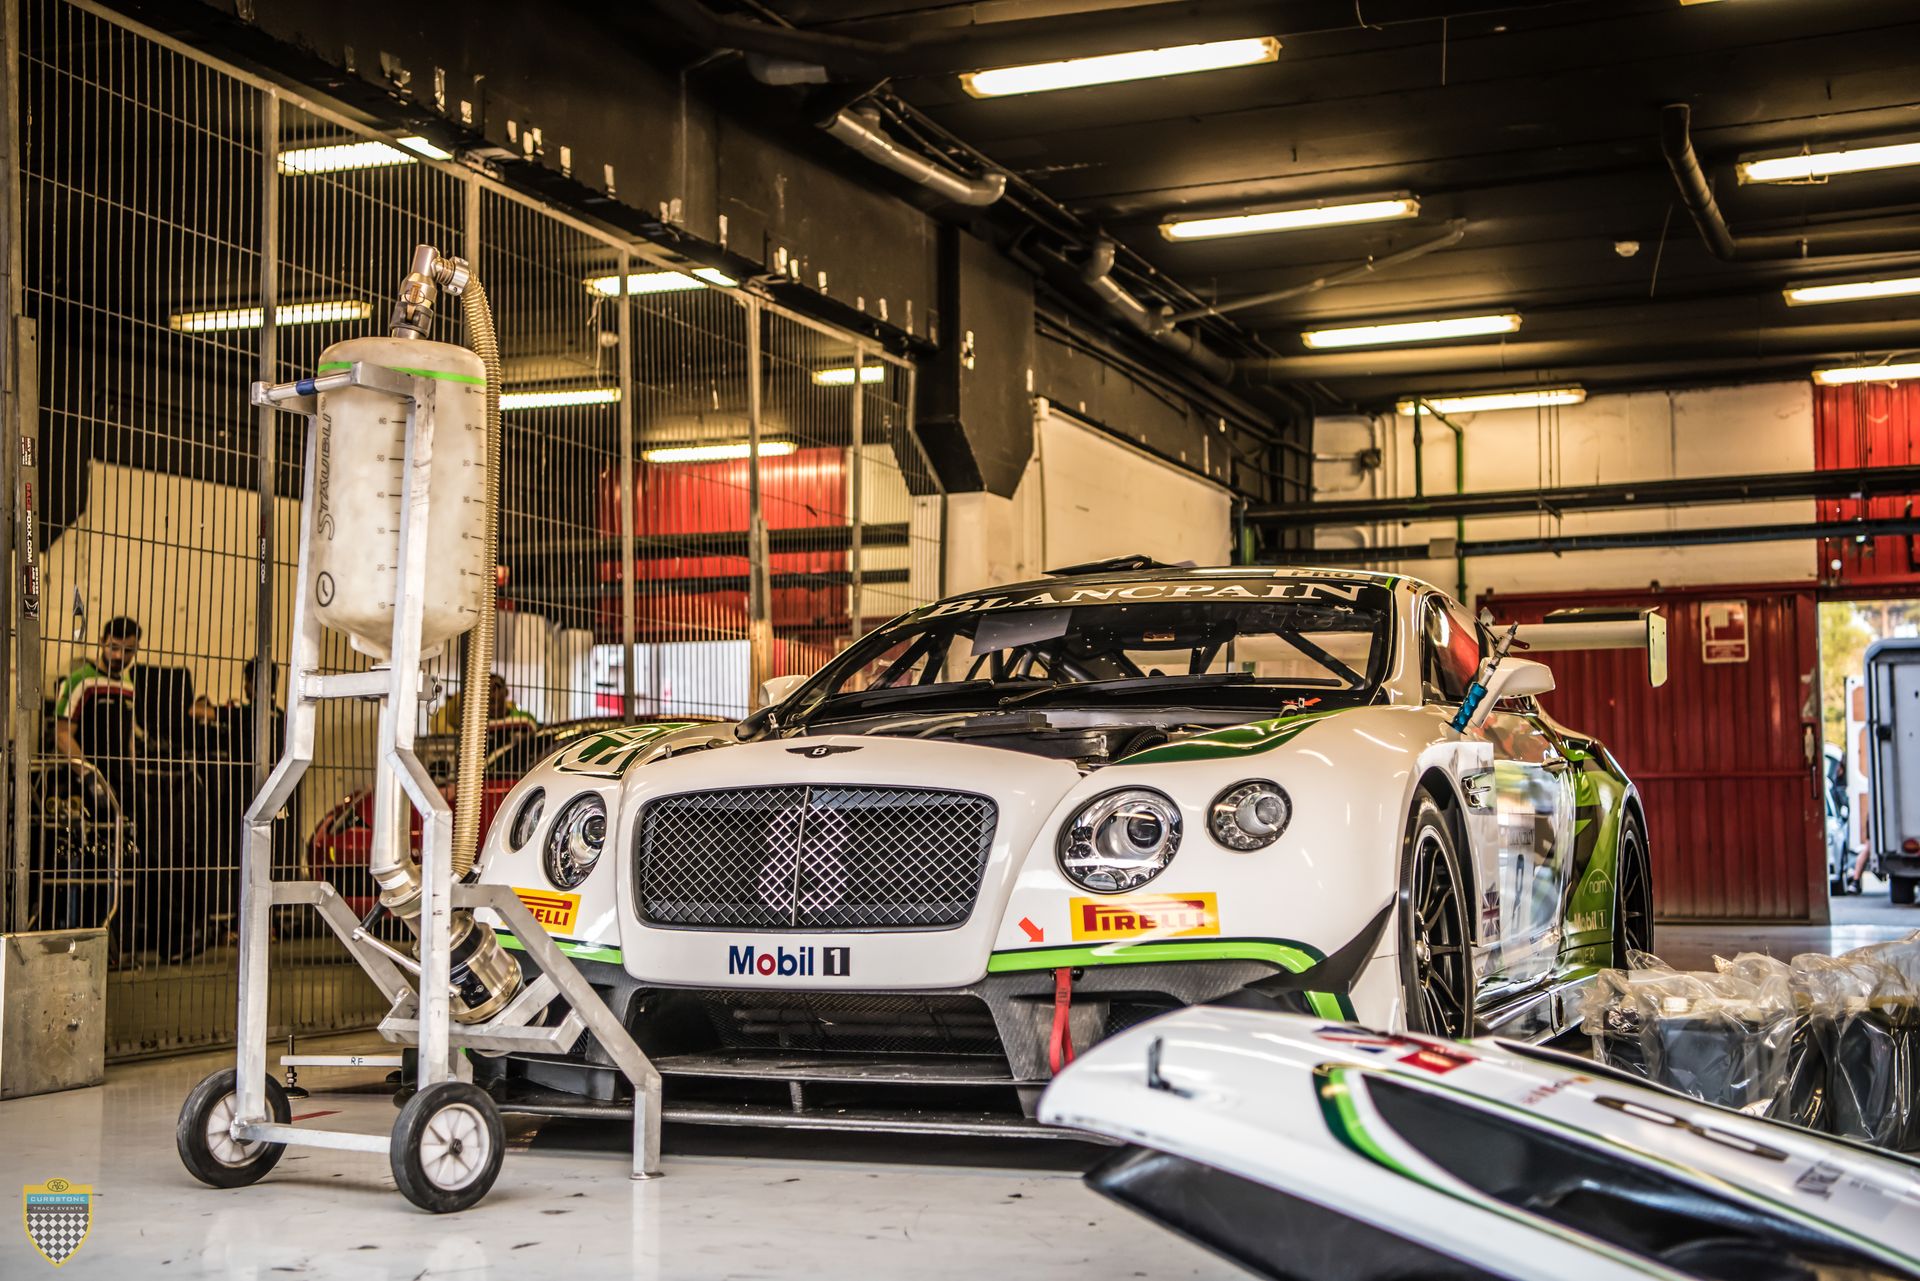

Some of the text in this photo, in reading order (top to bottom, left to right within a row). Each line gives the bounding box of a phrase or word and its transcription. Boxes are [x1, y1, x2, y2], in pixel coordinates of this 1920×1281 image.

[1291, 570, 1354, 578] PRO
[918, 583, 1368, 620] BLANCPAIN
[1083, 900, 1205, 932] PIRELLI
[729, 945, 845, 976] Mobil 1
[351, 1056, 363, 1066] RF
